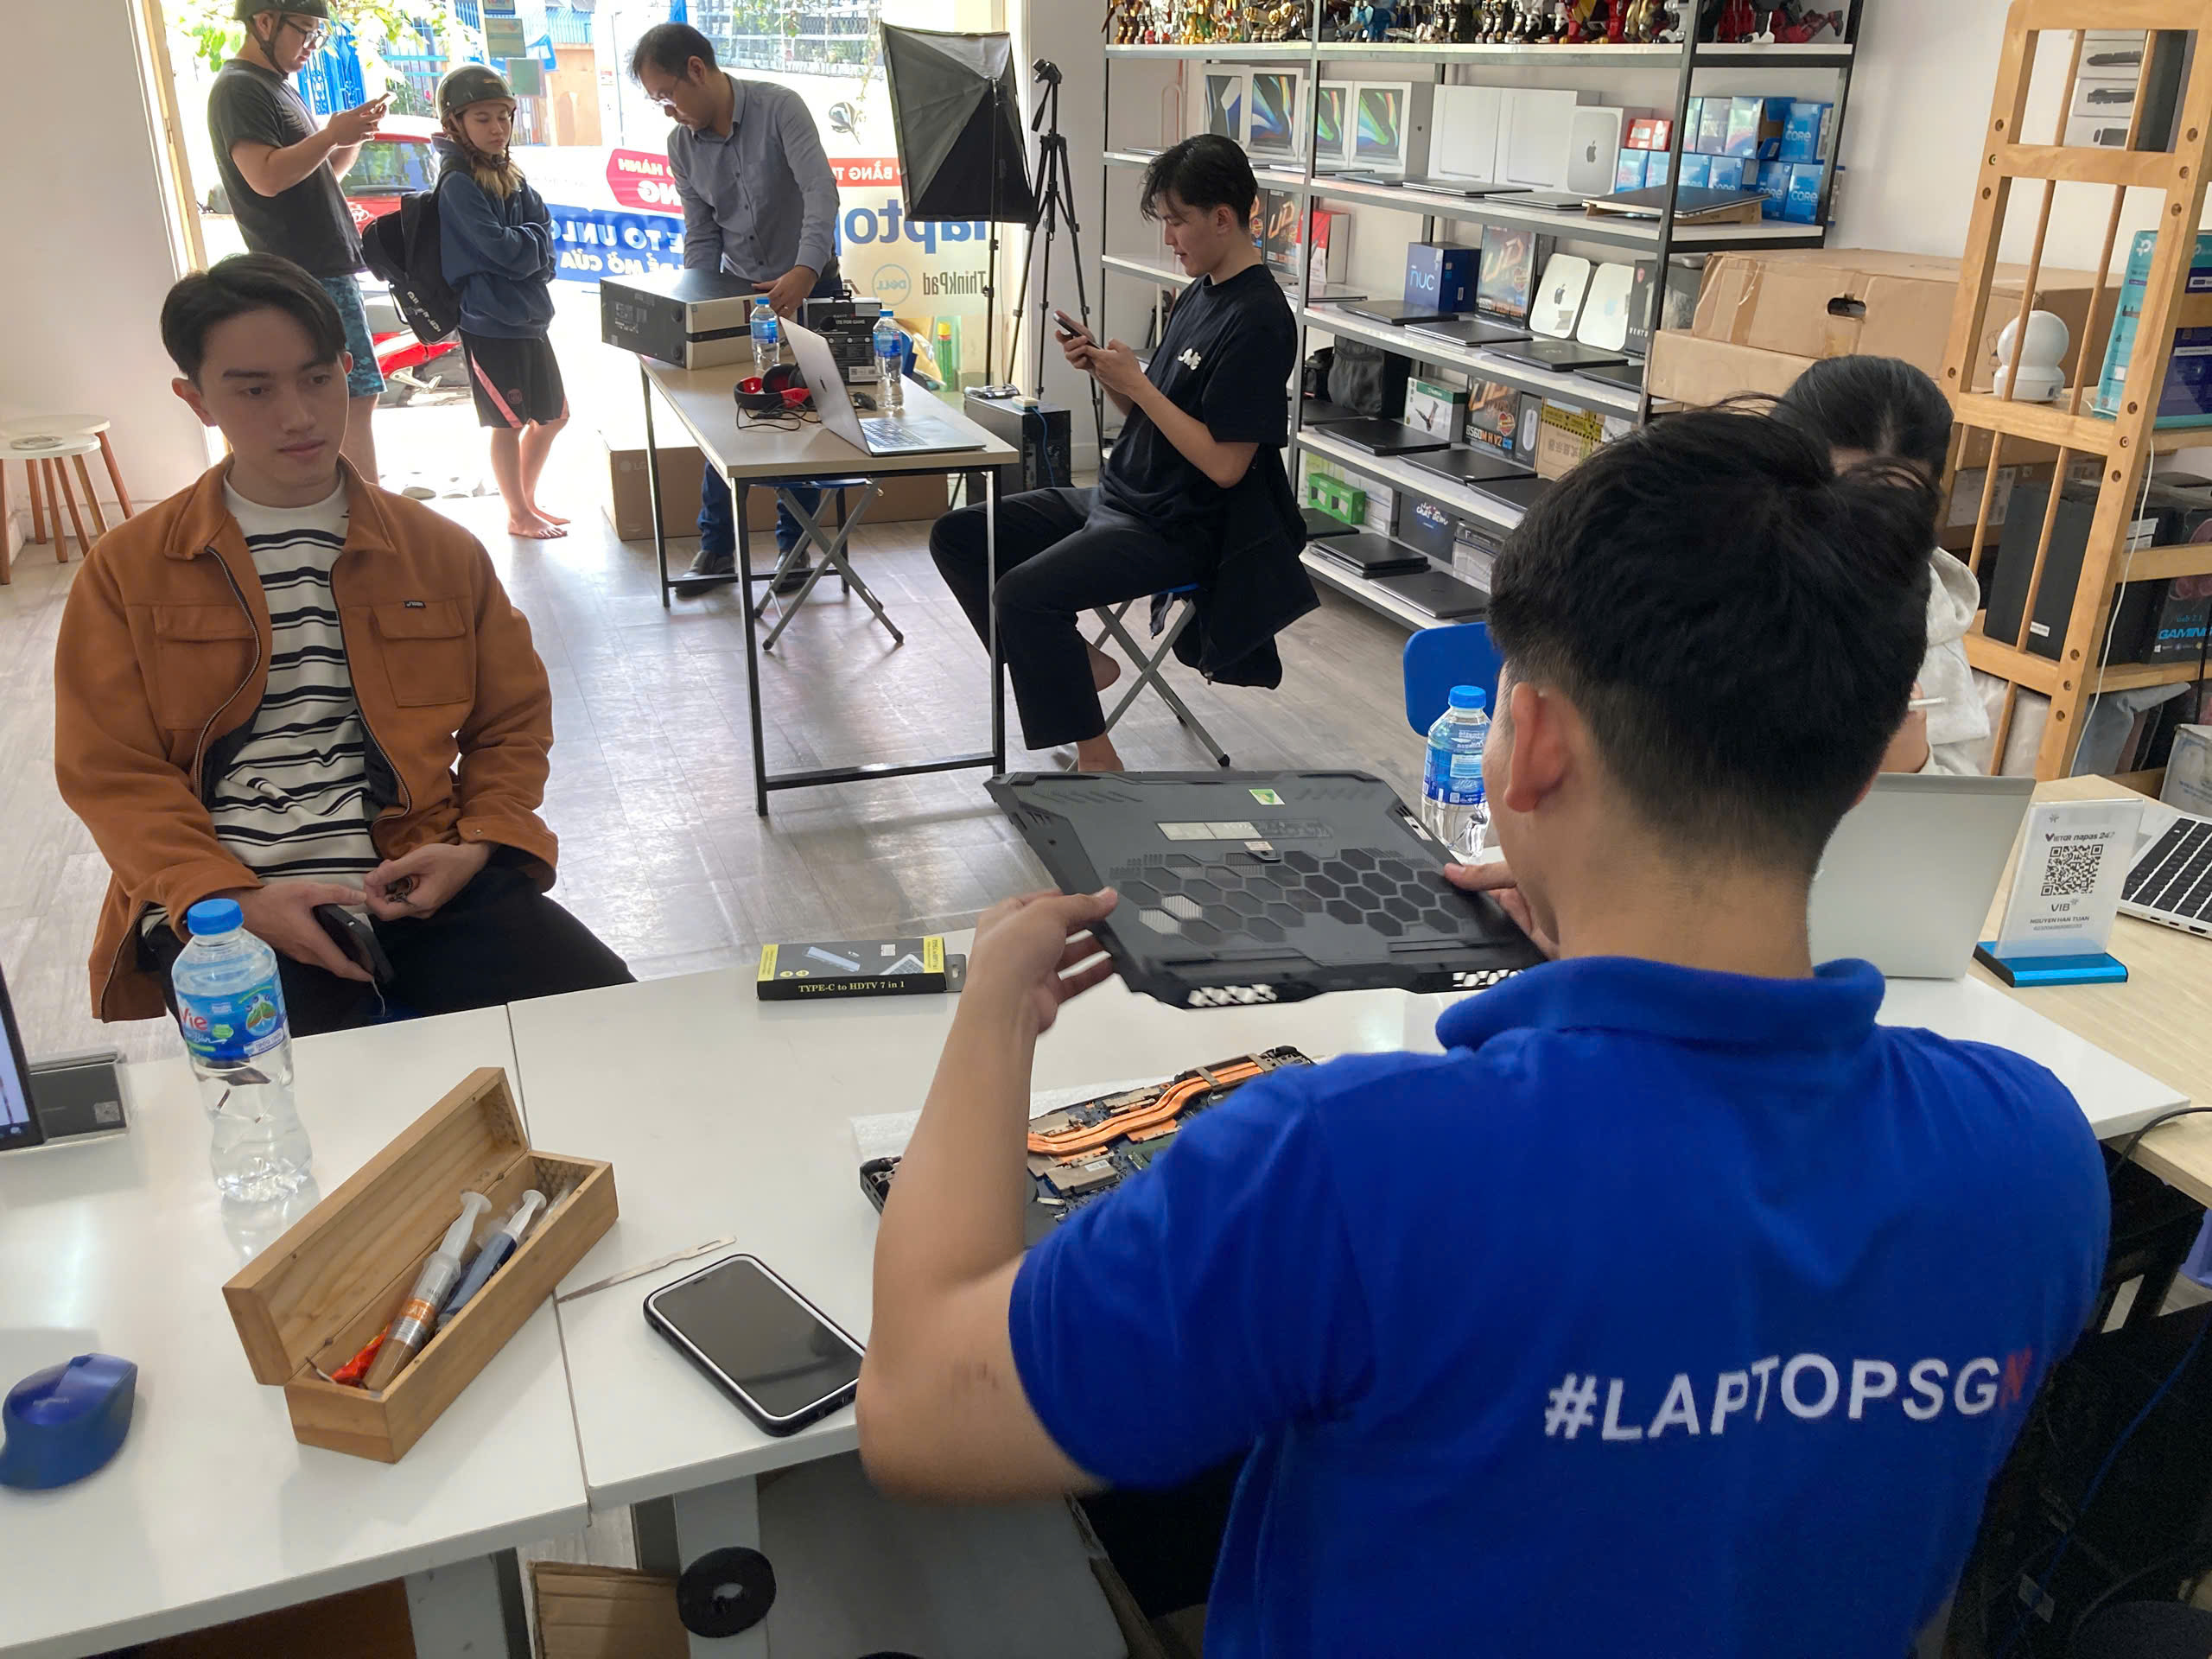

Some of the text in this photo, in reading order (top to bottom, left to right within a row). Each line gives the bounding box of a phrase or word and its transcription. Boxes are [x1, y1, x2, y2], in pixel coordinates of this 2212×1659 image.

[2073, 833, 2098, 842] napas
[2051, 902, 2070, 912] VIB
[798, 983, 836, 993] TYPE-C
[849, 982, 878, 990] HDTV
